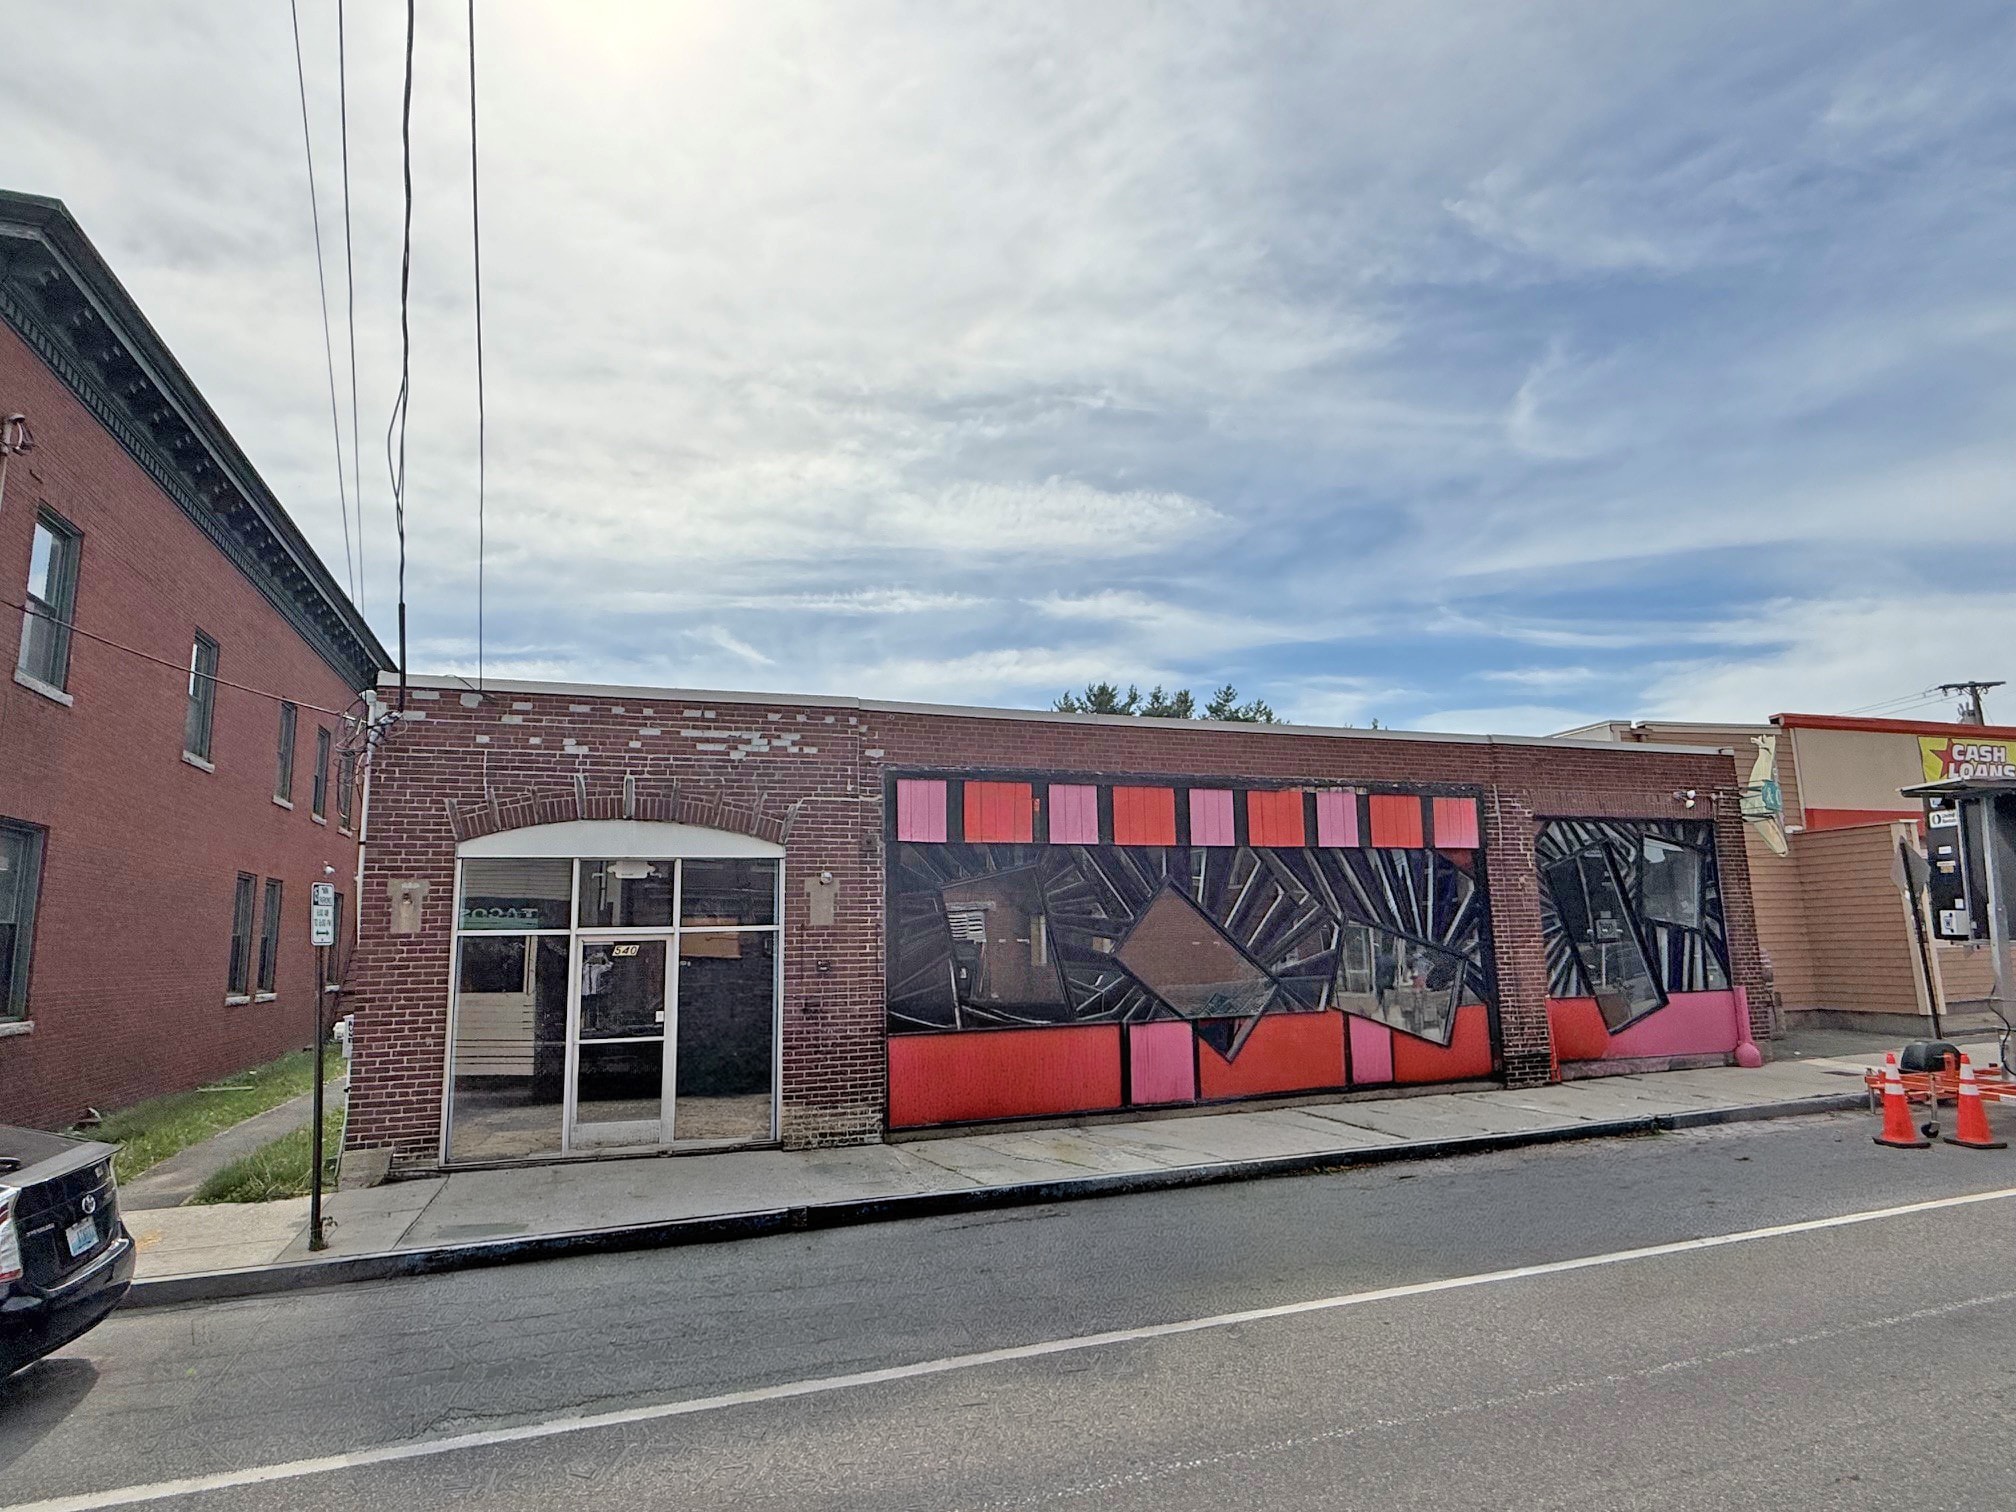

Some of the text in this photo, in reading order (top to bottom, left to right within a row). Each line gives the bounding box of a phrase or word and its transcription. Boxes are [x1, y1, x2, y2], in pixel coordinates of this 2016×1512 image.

[1952, 744, 2006, 763] CASH
[1948, 762, 2016, 779] LOANS
[614, 945, 638, 955] 540
